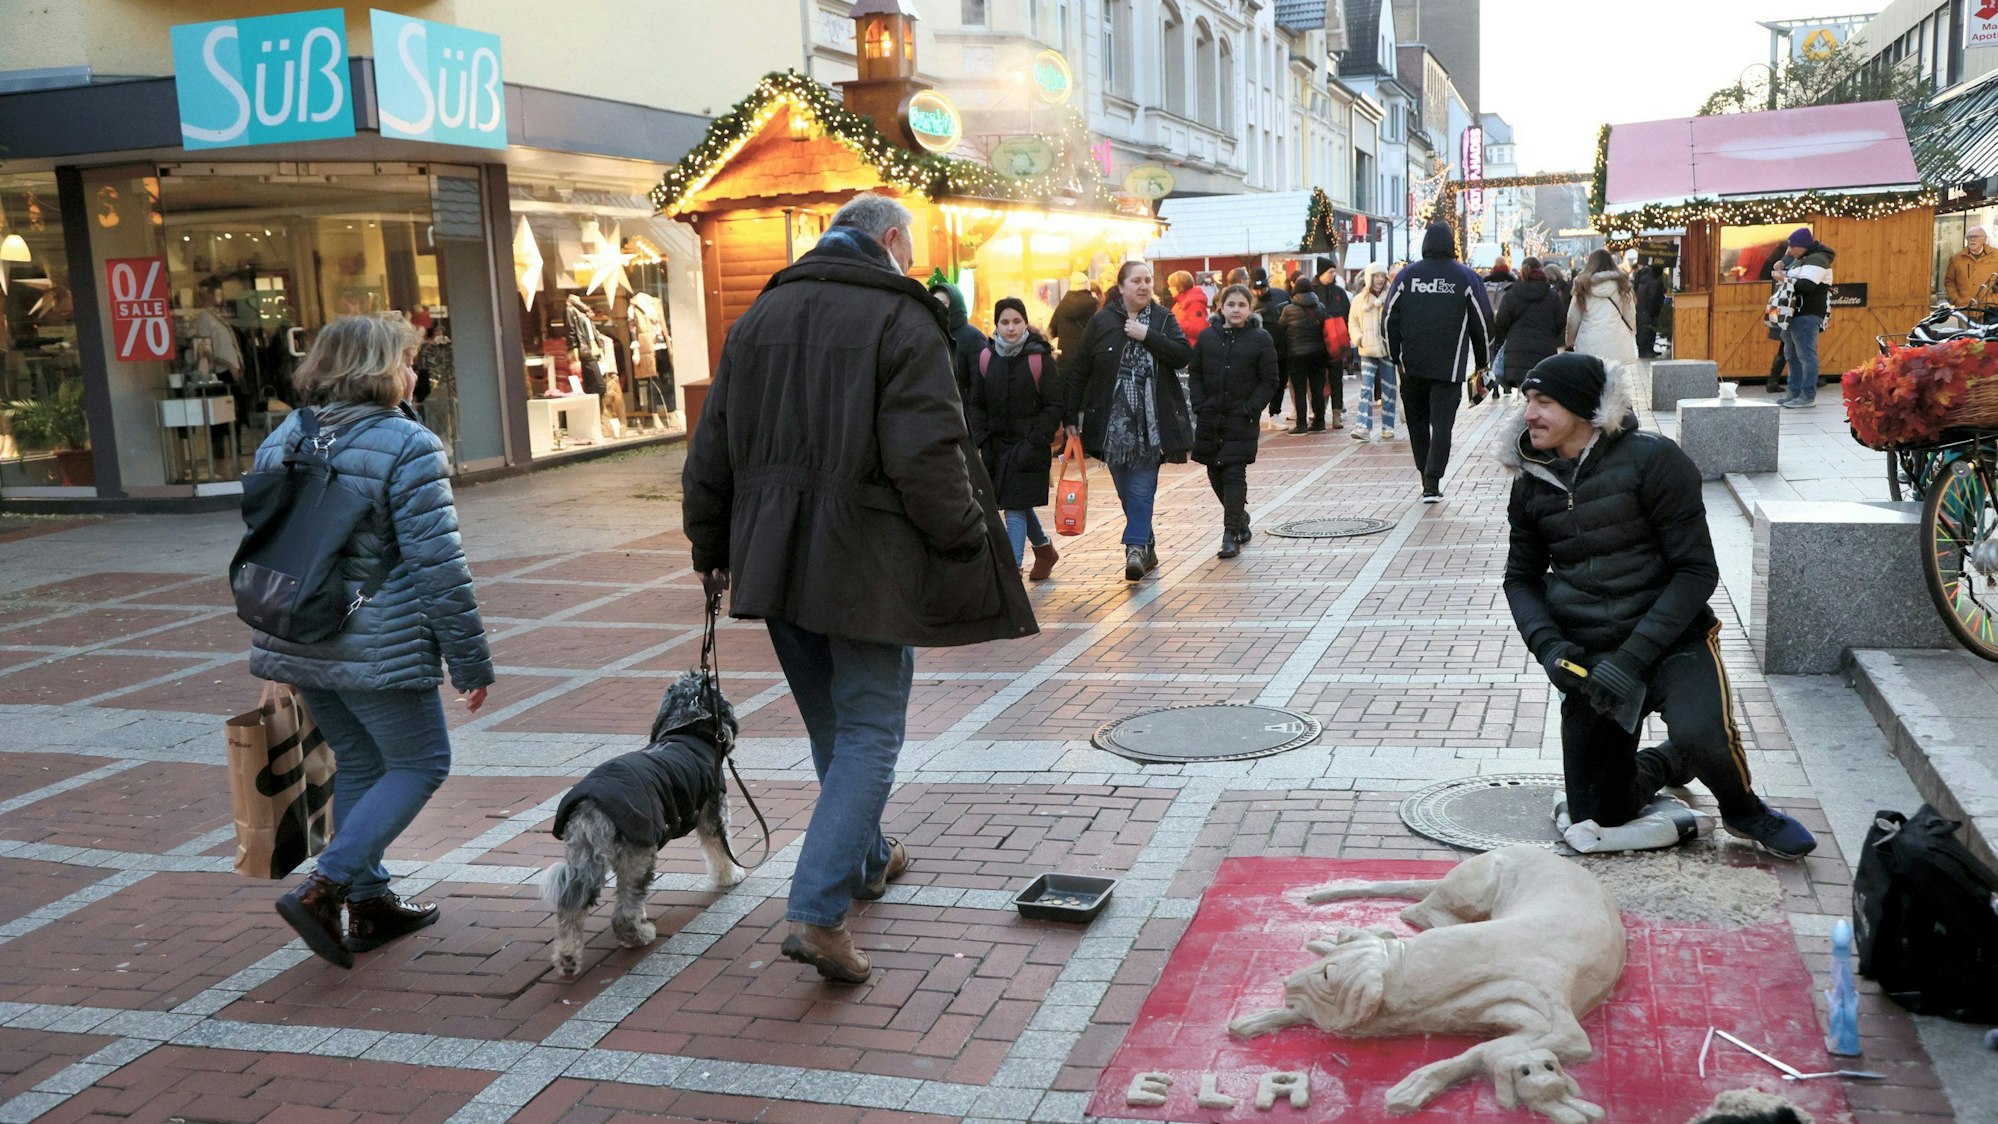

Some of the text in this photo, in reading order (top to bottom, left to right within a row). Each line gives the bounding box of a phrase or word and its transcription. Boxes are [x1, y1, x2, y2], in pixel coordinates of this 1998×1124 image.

[181, 25, 344, 142] Süß
[379, 22, 500, 135] Süß
[1411, 278, 1456, 293] FedEx
[119, 302, 163, 316] SALE
[1126, 1071, 1310, 1111] ELA
